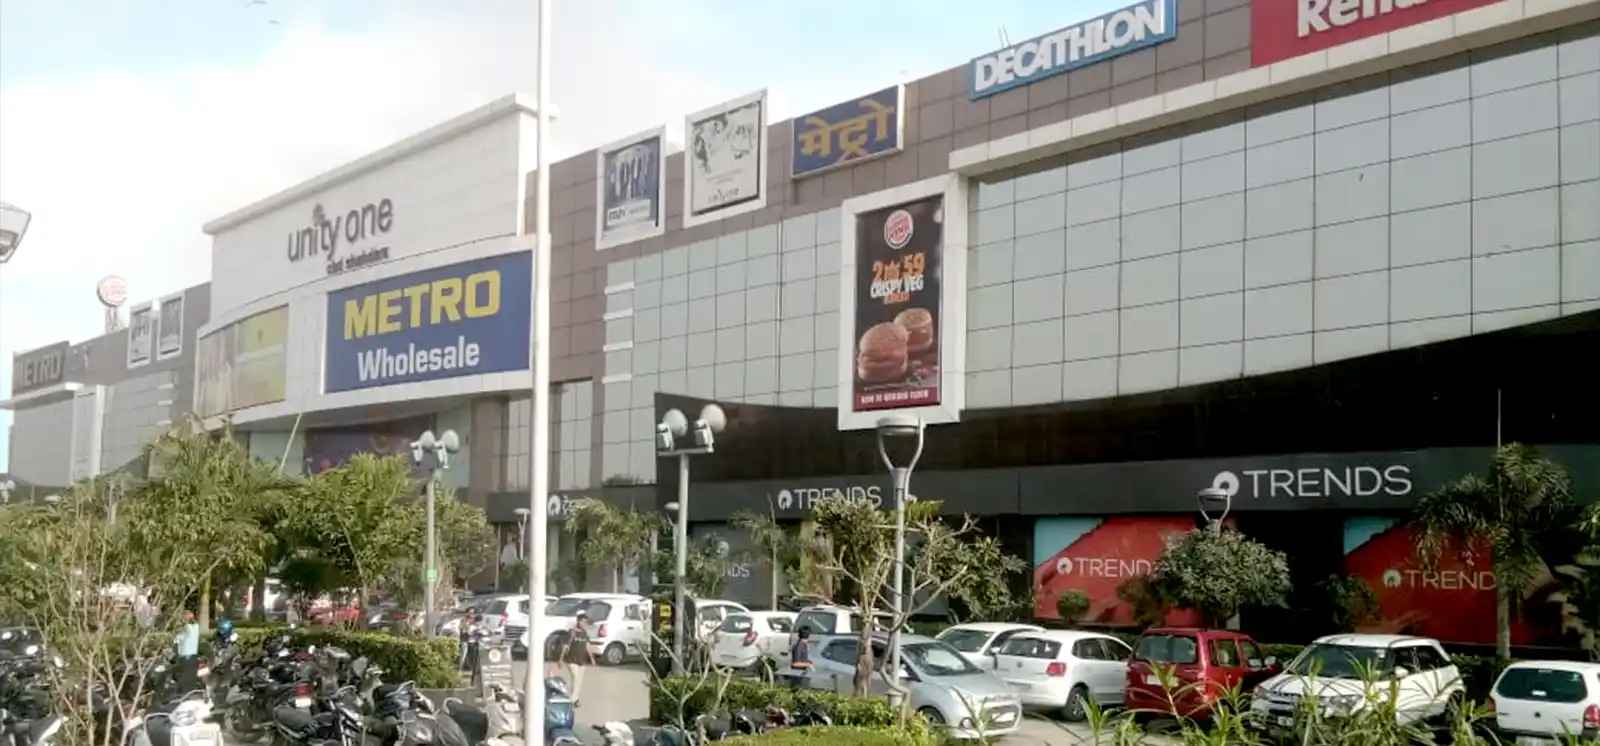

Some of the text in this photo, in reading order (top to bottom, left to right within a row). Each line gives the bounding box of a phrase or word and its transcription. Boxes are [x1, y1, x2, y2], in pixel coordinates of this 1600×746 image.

[976, 0, 1166, 92] DECATHLON
[799, 99, 895, 163] मेट्रो
[288, 198, 393, 262] unity one
[344, 269, 501, 340] METRO
[358, 335, 480, 382] Wholesale
[1242, 465, 1413, 498] TRENDS
[1073, 557, 1151, 577] TREND
[1404, 569, 1497, 591] TREND
